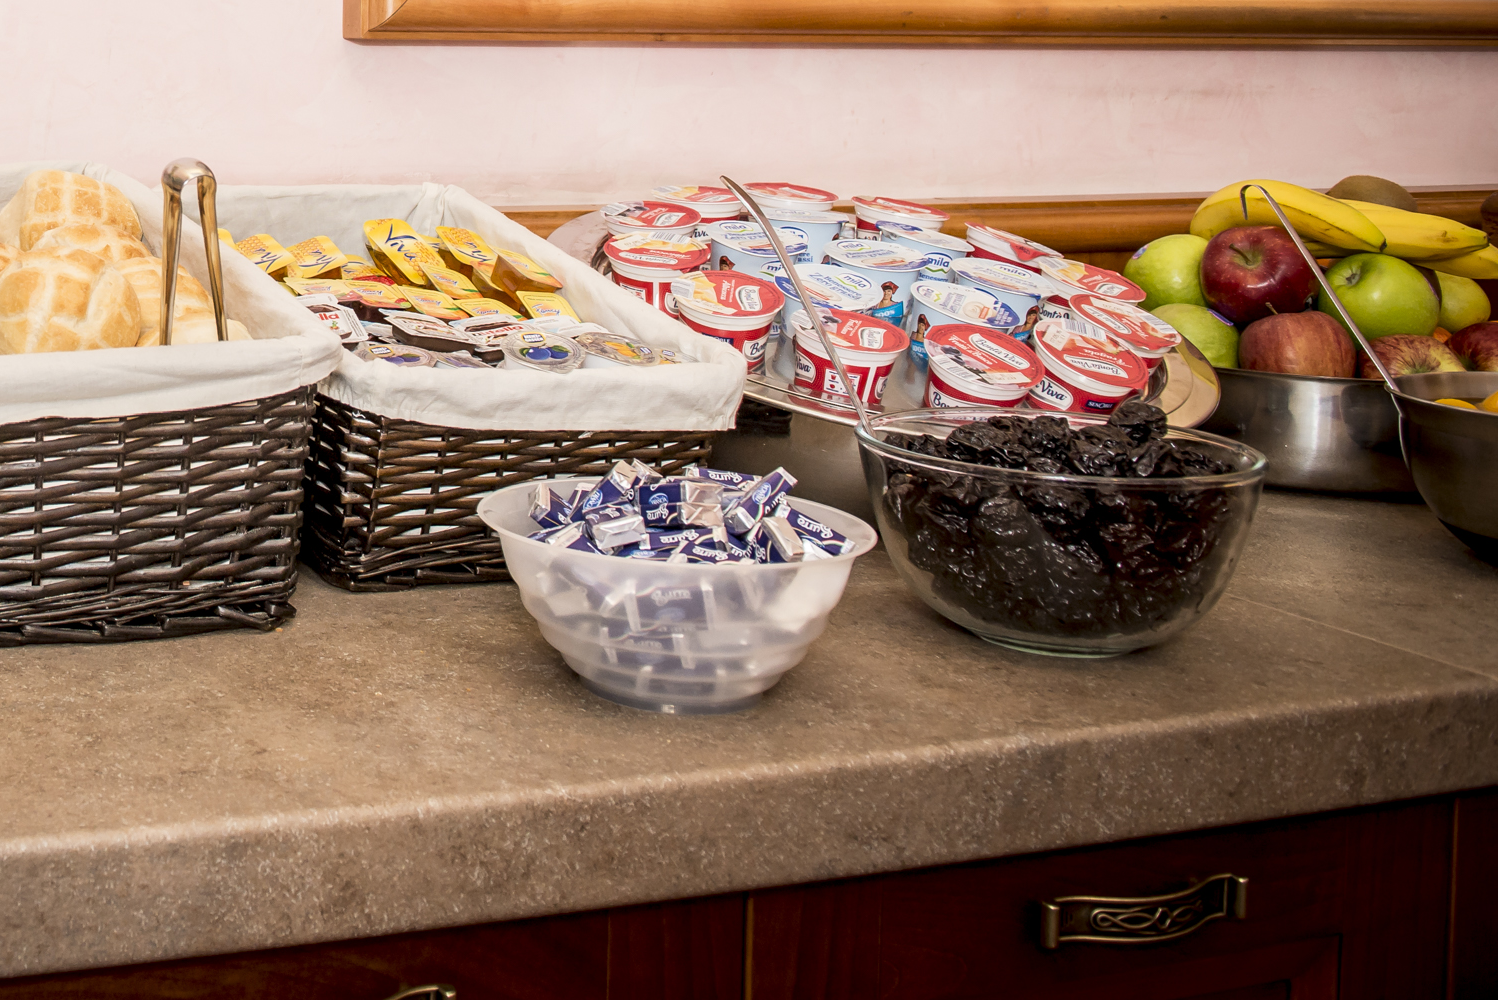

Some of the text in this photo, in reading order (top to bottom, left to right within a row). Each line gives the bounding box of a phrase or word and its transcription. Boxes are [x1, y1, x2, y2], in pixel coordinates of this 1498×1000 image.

[385, 223, 418, 261] Viva
[928, 255, 950, 268] mila
[843, 275, 867, 288] mila
[1070, 359, 1120, 375] Bontà Viva
[1041, 380, 1066, 401] Viva
[708, 470, 743, 484] Burro
[646, 503, 669, 520] Burro
[796, 514, 834, 539] Burro
[659, 529, 700, 543] Burro
[692, 545, 729, 561] Burro
